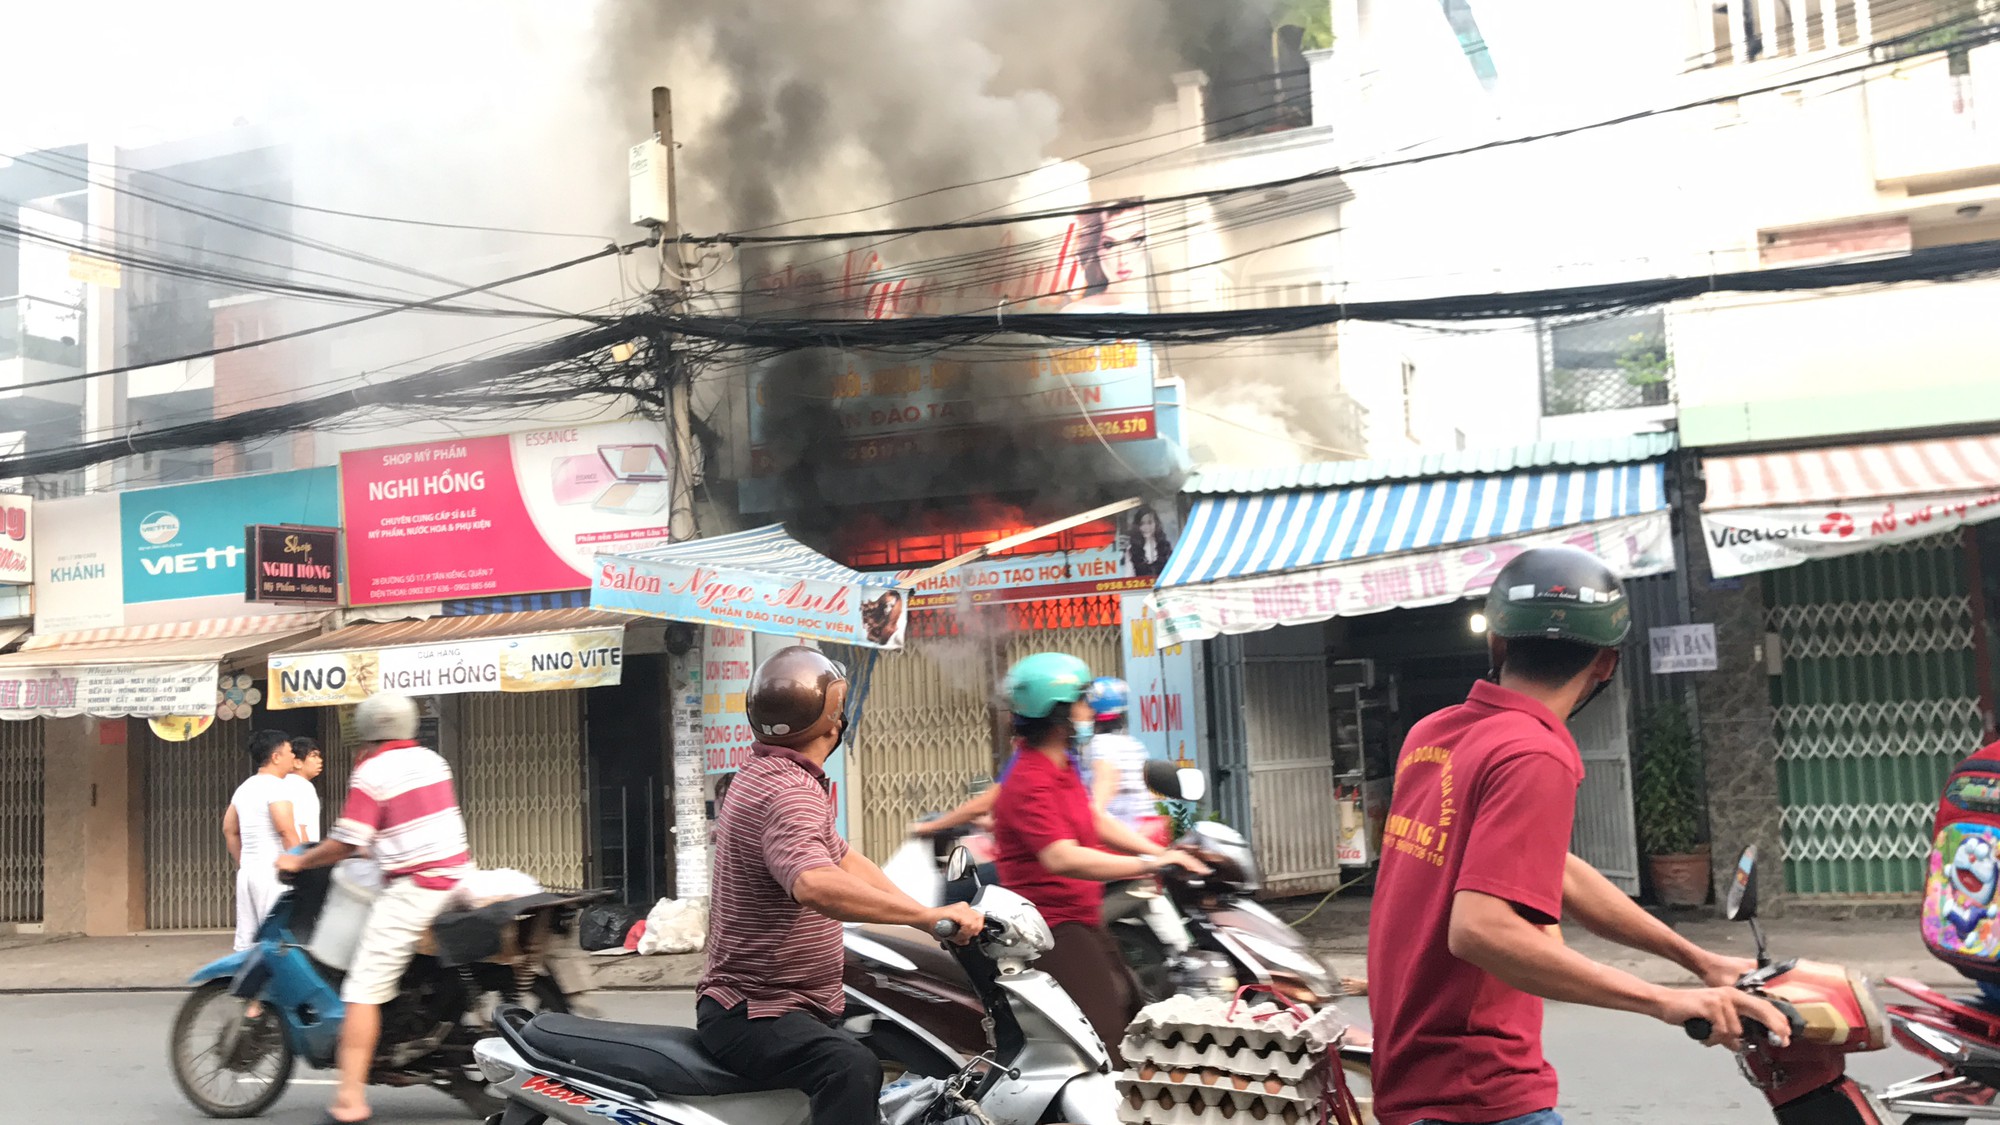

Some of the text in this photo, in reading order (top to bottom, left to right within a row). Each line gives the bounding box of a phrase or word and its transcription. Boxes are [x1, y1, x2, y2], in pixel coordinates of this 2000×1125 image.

[525, 428, 579, 447] ESSANCE
[383, 452, 412, 466] SHOP
[414, 448, 431, 463] MỸ
[369, 478, 419, 501] NGHI
[381, 514, 411, 526] CHUYÊN
[412, 513, 434, 523] CUNG
[430, 523, 447, 533] HOA
[284, 535, 312, 562] Shop
[51, 562, 105, 583] KHÁNH
[262, 562, 294, 578] NGHI
[916, 572, 961, 592] NHẬN
[1003, 568, 1034, 586] TẠO
[1038, 565, 1071, 582] HỌC
[1077, 559, 1118, 577] VIÊN
[600, 562, 851, 617] Salon Ngọc Anh
[745, 609, 771, 621] ĐÀO
[797, 616, 821, 631] HỌC
[825, 619, 855, 634] VIÊN
[1652, 627, 1712, 656] NHÀ BÁN
[531, 647, 622, 672] NNO VITE
[722, 660, 749, 681] SETTING
[281, 666, 347, 693] NNO
[383, 658, 497, 690] NGHI HỒNG
